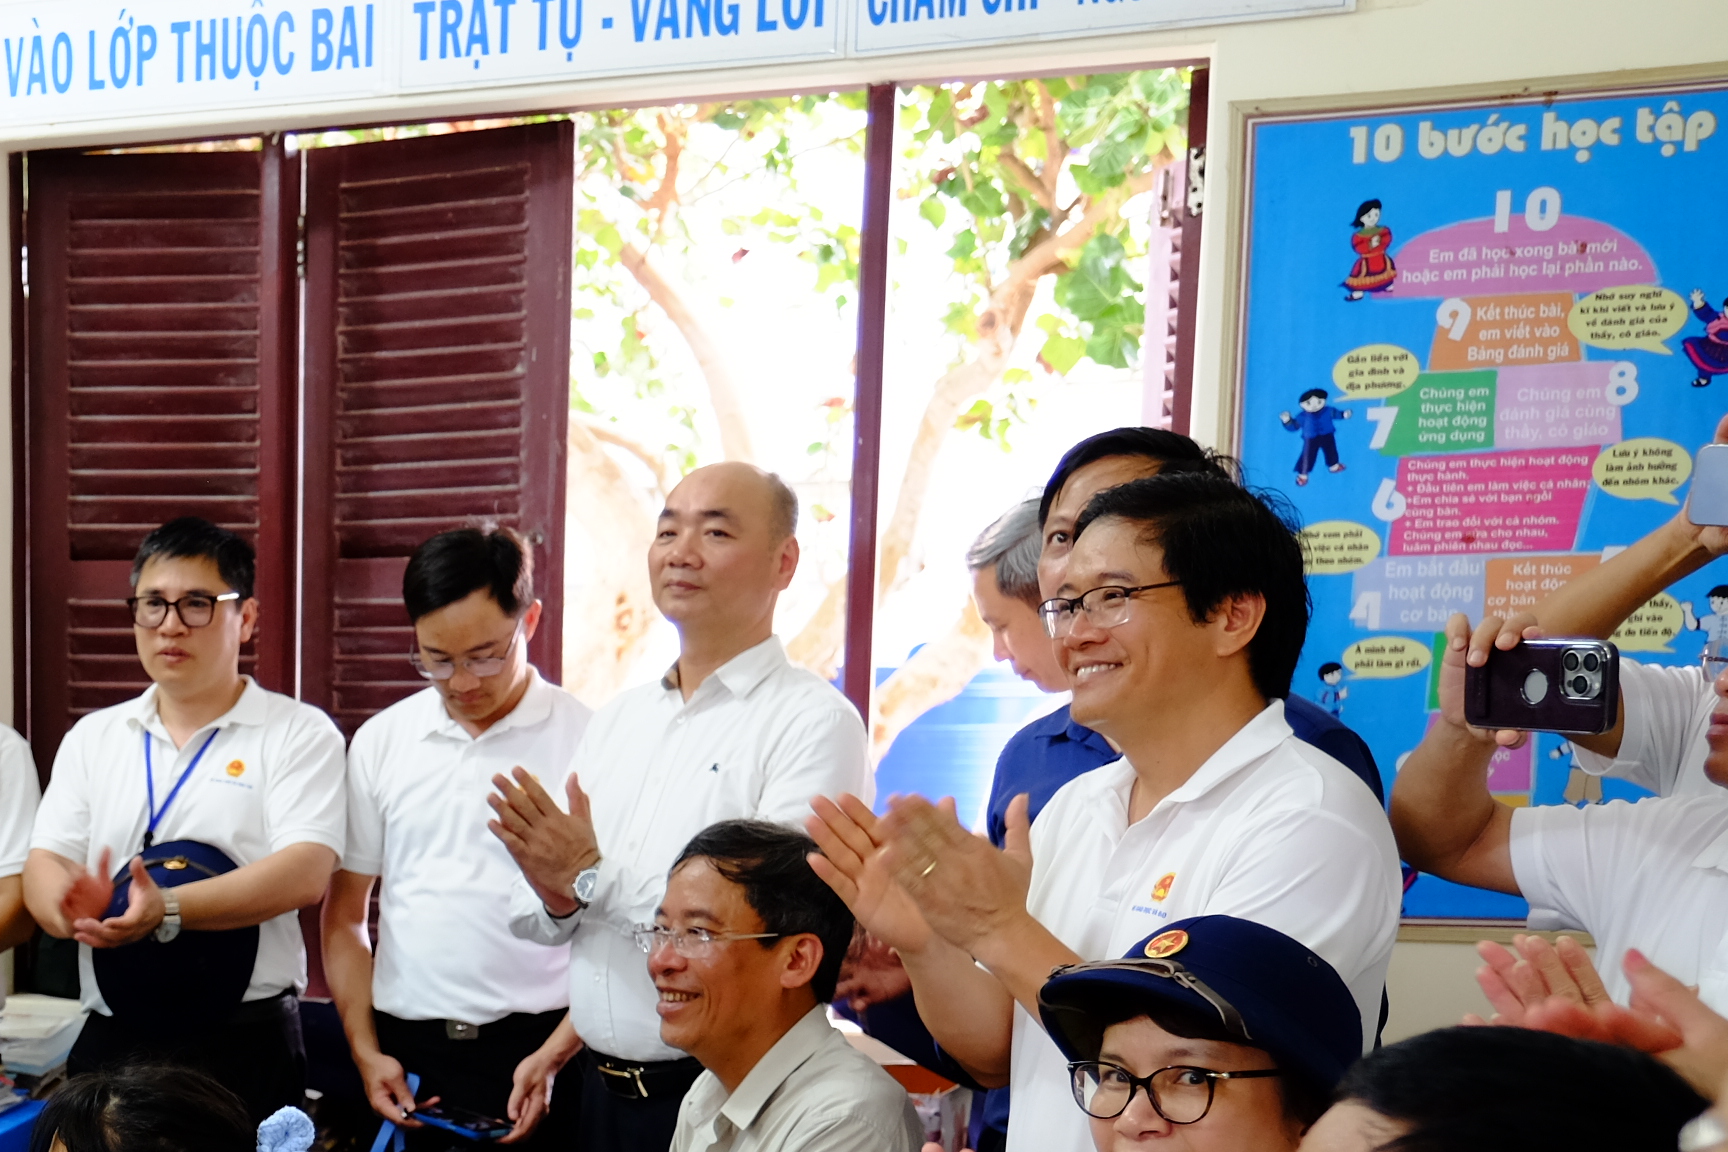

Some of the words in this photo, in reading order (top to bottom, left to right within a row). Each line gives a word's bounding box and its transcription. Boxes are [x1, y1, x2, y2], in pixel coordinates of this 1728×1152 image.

[3, 17, 73, 97] VÀO
[88, 8, 157, 90] LỚP
[170, 0, 295, 91] THUỘC
[1349, 122, 1404, 164] 10
[1417, 113, 1528, 159] bước
[1540, 112, 1622, 164] học
[1635, 100, 1717, 157] tập
[1494, 186, 1562, 233] 10
[1429, 249, 1454, 264] Em
[1458, 246, 1477, 262] đã
[1481, 245, 1511, 263] học
[1515, 244, 1553, 262] xong
[1586, 239, 1617, 254] mới
[1402, 267, 1440, 285] hoặc
[1444, 268, 1467, 281] em
[1471, 262, 1505, 282] phải
[1509, 263, 1537, 280] học
[1542, 261, 1561, 277] lại
[1564, 258, 1604, 278] phần
[1608, 257, 1643, 272] nào.
[1435, 297, 1472, 341] 9
[1476, 302, 1500, 321] Kết
[1504, 304, 1535, 321] thúc
[1540, 302, 1565, 319] bài,
[1479, 328, 1500, 341] em
[1505, 321, 1530, 338] viết
[1534, 324, 1560, 338] vào
[1467, 345, 1503, 363] Bảng
[1508, 344, 1543, 359] đánh
[1547, 341, 1569, 360] giá
[1604, 360, 1639, 406] 8
[1419, 387, 1465, 400] Chúng
[1468, 387, 1489, 397] em
[1517, 387, 1571, 403] Chúng
[1582, 387, 1601, 399] em
[1421, 401, 1453, 415] thực
[1456, 400, 1486, 413] hiện
[1366, 405, 1399, 450] 7
[1418, 416, 1449, 429] hoạt
[1452, 415, 1487, 429] động
[1418, 429, 1446, 444] ứng
[1450, 430, 1485, 443] dụng
[1407, 458, 1446, 471] Chúng
[1449, 460, 1467, 469] em
[1471, 456, 1497, 469] thực
[1500, 455, 1525, 468] hiện
[1529, 455, 1556, 467] hoạt
[1558, 454, 1589, 467] động
[1407, 471, 1434, 483] thực
[1437, 470, 1469, 481] hành.
[1371, 477, 1407, 522] 6
[1385, 561, 1412, 578] Em
[1417, 556, 1443, 577] bắt
[1448, 555, 1480, 576] đầu
[1513, 561, 1536, 576] Kết
[1540, 560, 1572, 576] thúc
[1388, 584, 1427, 603] hoạt
[1430, 583, 1474, 601] động
[1506, 577, 1537, 593] hoạt
[1487, 594, 1507, 607] cơ
[1510, 592, 1536, 606] bản
[1349, 590, 1382, 631] 4
